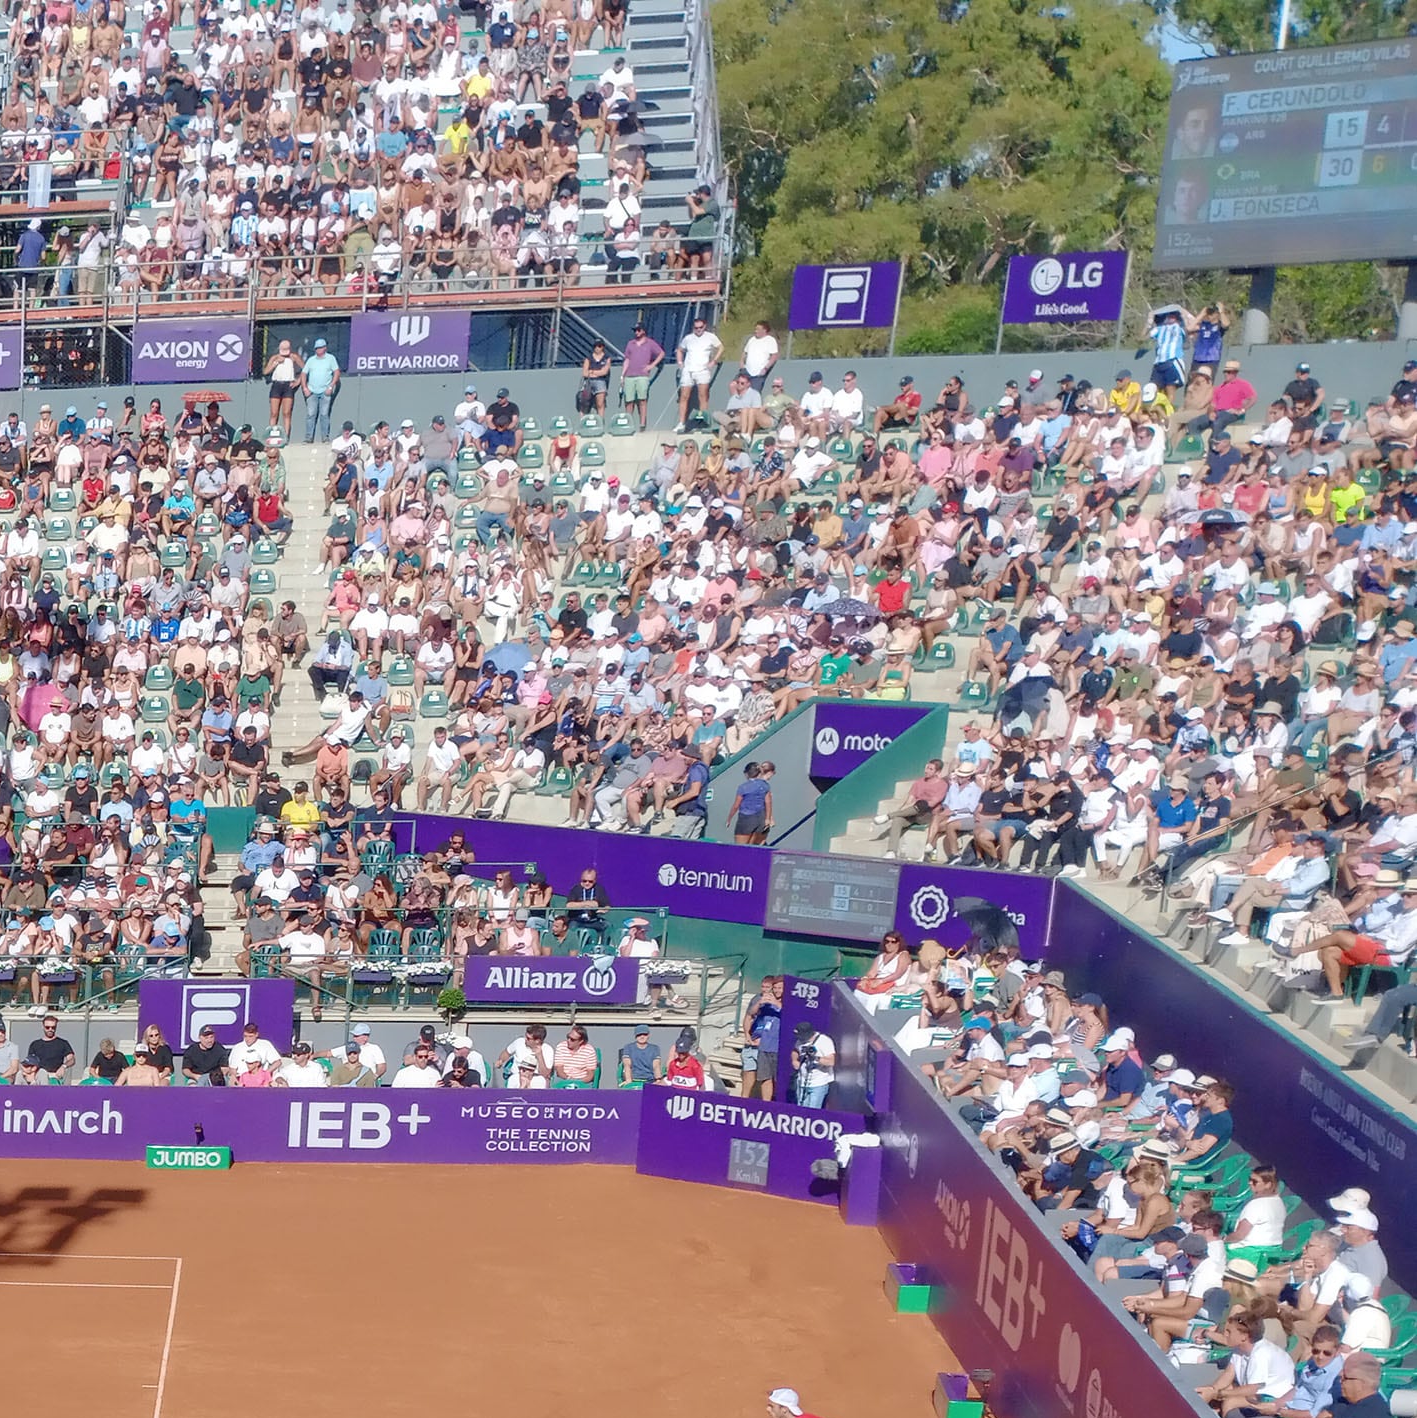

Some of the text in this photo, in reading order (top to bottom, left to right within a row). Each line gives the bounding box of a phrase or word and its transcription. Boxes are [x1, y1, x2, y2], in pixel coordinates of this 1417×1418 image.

[1254, 58, 1294, 73] COURT
[1297, 49, 1371, 70] GUILLERMO
[1374, 44, 1412, 60] VILAS
[1225, 83, 1367, 113] F. CERUNDOLO
[1336, 117, 1358, 138] 15
[1376, 114, 1390, 133] 4
[1328, 157, 1353, 177] 30
[1213, 195, 1320, 218] J. FONSECA
[1167, 233, 1190, 247] 152
[1066, 261, 1104, 289] LG
[1035, 302, 1089, 316] Life's Good.
[138, 340, 209, 360] AXION
[175, 359, 208, 369] energy
[356, 354, 459, 370] BETWARRIOR
[679, 864, 753, 893] tennium
[485, 966, 576, 990] Allianz
[461, 1106, 620, 1120] MUSEO MODA
[700, 1102, 842, 1142] BETWARRIOR
[288, 1101, 432, 1149] IEB+
[486, 1128, 591, 1140] THE TENNIS
[486, 1140, 591, 1152] COLLECTION
[732, 1141, 770, 1168] 152
[153, 1151, 221, 1166] JUMBO
[975, 1196, 1047, 1352] IEB+
